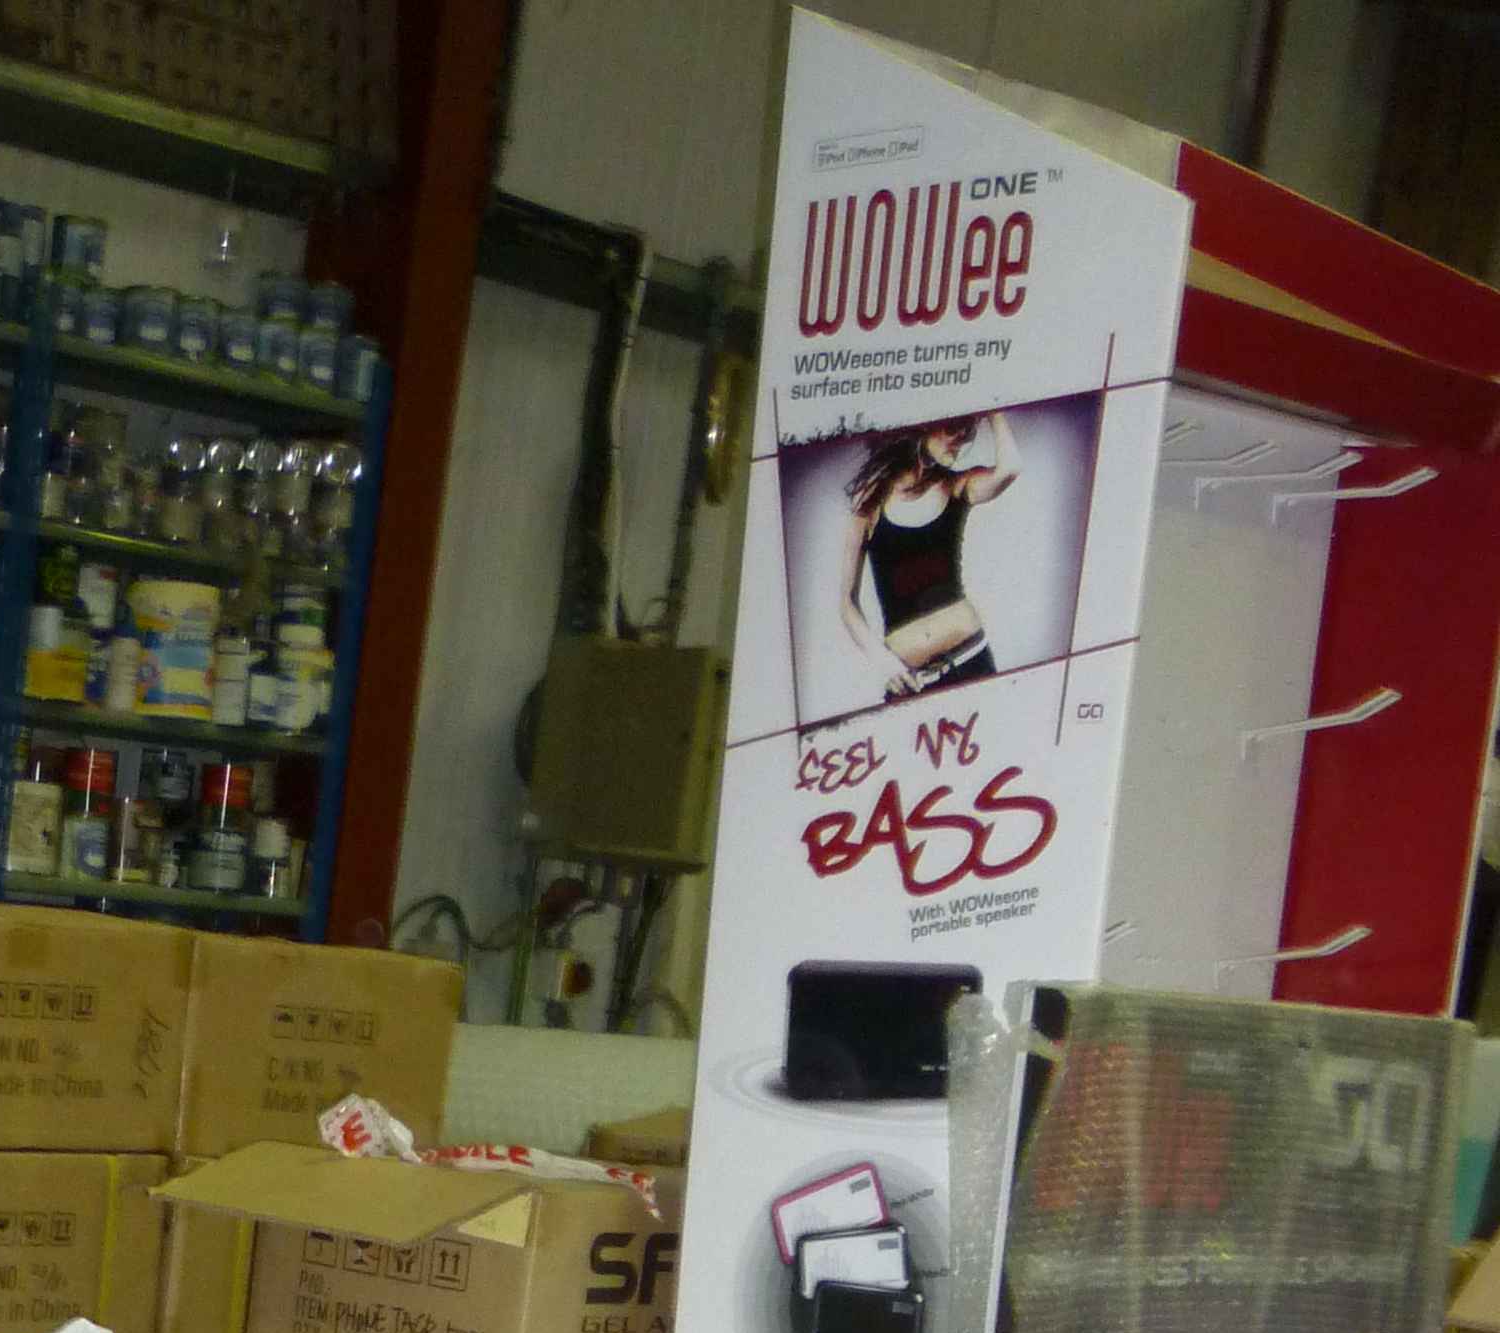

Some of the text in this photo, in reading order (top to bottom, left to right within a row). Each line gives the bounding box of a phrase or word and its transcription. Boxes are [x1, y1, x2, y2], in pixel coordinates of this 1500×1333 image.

[970, 171, 1039, 200] ONE
[794, 337, 1013, 376] WOWeeone turns any
[790, 363, 972, 401] surface into sound
[800, 766, 1058, 898] BASS
[909, 886, 1040, 925] With WOWeeone
[910, 901, 1037, 943] portable speaker
